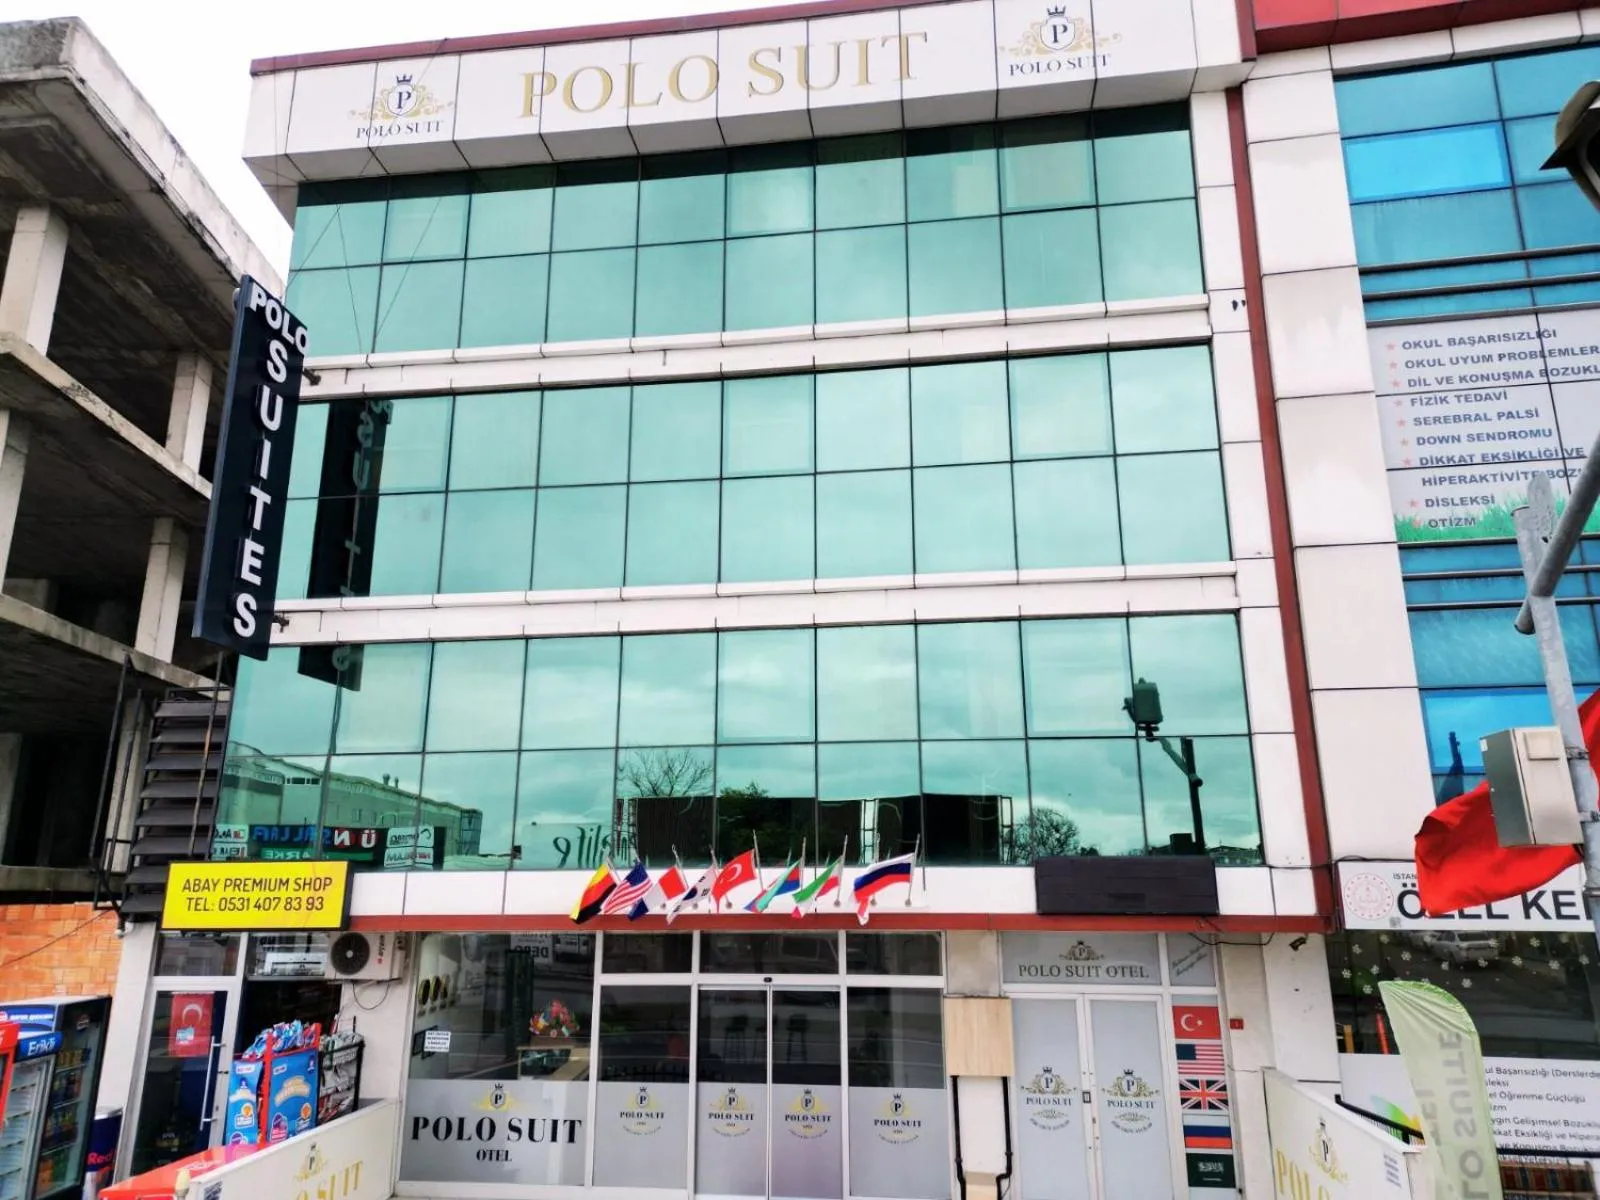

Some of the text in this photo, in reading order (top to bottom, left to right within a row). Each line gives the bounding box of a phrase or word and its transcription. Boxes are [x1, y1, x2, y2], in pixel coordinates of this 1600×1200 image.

[1051, 24, 1068, 44] P
[1009, 53, 1111, 77] POLO SUIT
[518, 31, 928, 118] POLO SUIT
[397, 90, 412, 110] P
[356, 120, 443, 140] POLO SUIT
[250, 282, 311, 357] POLO
[1402, 329, 1557, 350] OKUL BAŞARISIZLIĞI
[1405, 358, 1446, 369] OKUL
[1450, 354, 1494, 366] UYUM
[1408, 375, 1431, 388] DİL
[1436, 373, 1454, 386] VE
[1459, 369, 1534, 384] KONUŞMA
[1410, 390, 1508, 407] FİZİK TEDAVİ
[1413, 407, 1539, 426] SEREBRAL PALSİ
[1416, 428, 1552, 446] DOWN SENDROMU
[1419, 447, 1585, 466] DİKKAT EKSİKLİĞİ VE
[1546, 466, 1582, 481] BOZ
[233, 338, 289, 639] SUITES
[1425, 494, 1495, 508] DİSLEKSİ
[1428, 517, 1476, 528] OTİZM
[182, 877, 333, 893] ABAY PREMIUM SHOP
[186, 896, 324, 911] TEL: 0531 407 83 93
[1397, 882, 1593, 920] ÖL KE
[1018, 964, 1149, 979] POLO SUIT OTEL
[495, 1094, 502, 1105] P
[639, 1095, 646, 1105] P
[728, 1096, 736, 1107] P
[804, 1097, 812, 1108] P
[1026, 1097, 1051, 1105] POLO
[1107, 1100, 1133, 1108] POLO
[619, 1111, 665, 1119] POLO SUIT
[894, 1102, 902, 1113] P
[708, 1112, 754, 1121] POLO SUIT
[785, 1114, 831, 1122] POLO SUIT
[874, 1119, 922, 1127] POLO SUIT
[411, 1116, 582, 1144] POLO SUIT
[476, 1149, 512, 1162] OTEL
